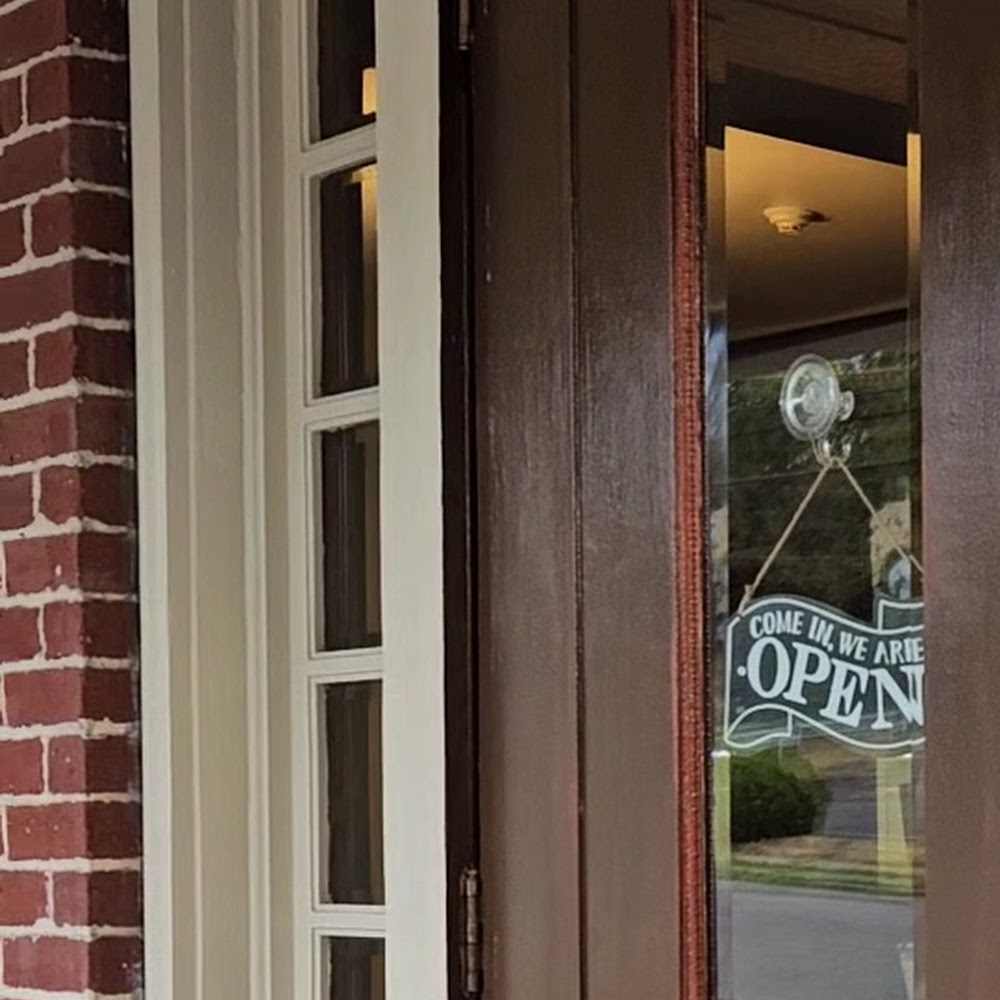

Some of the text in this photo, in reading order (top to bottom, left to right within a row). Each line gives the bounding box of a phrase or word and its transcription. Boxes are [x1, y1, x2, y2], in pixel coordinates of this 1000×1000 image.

[750, 610, 805, 639] COME
[808, 615, 834, 652] IN,
[839, 630, 869, 661] WE
[747, 636, 925, 730] OPEN
